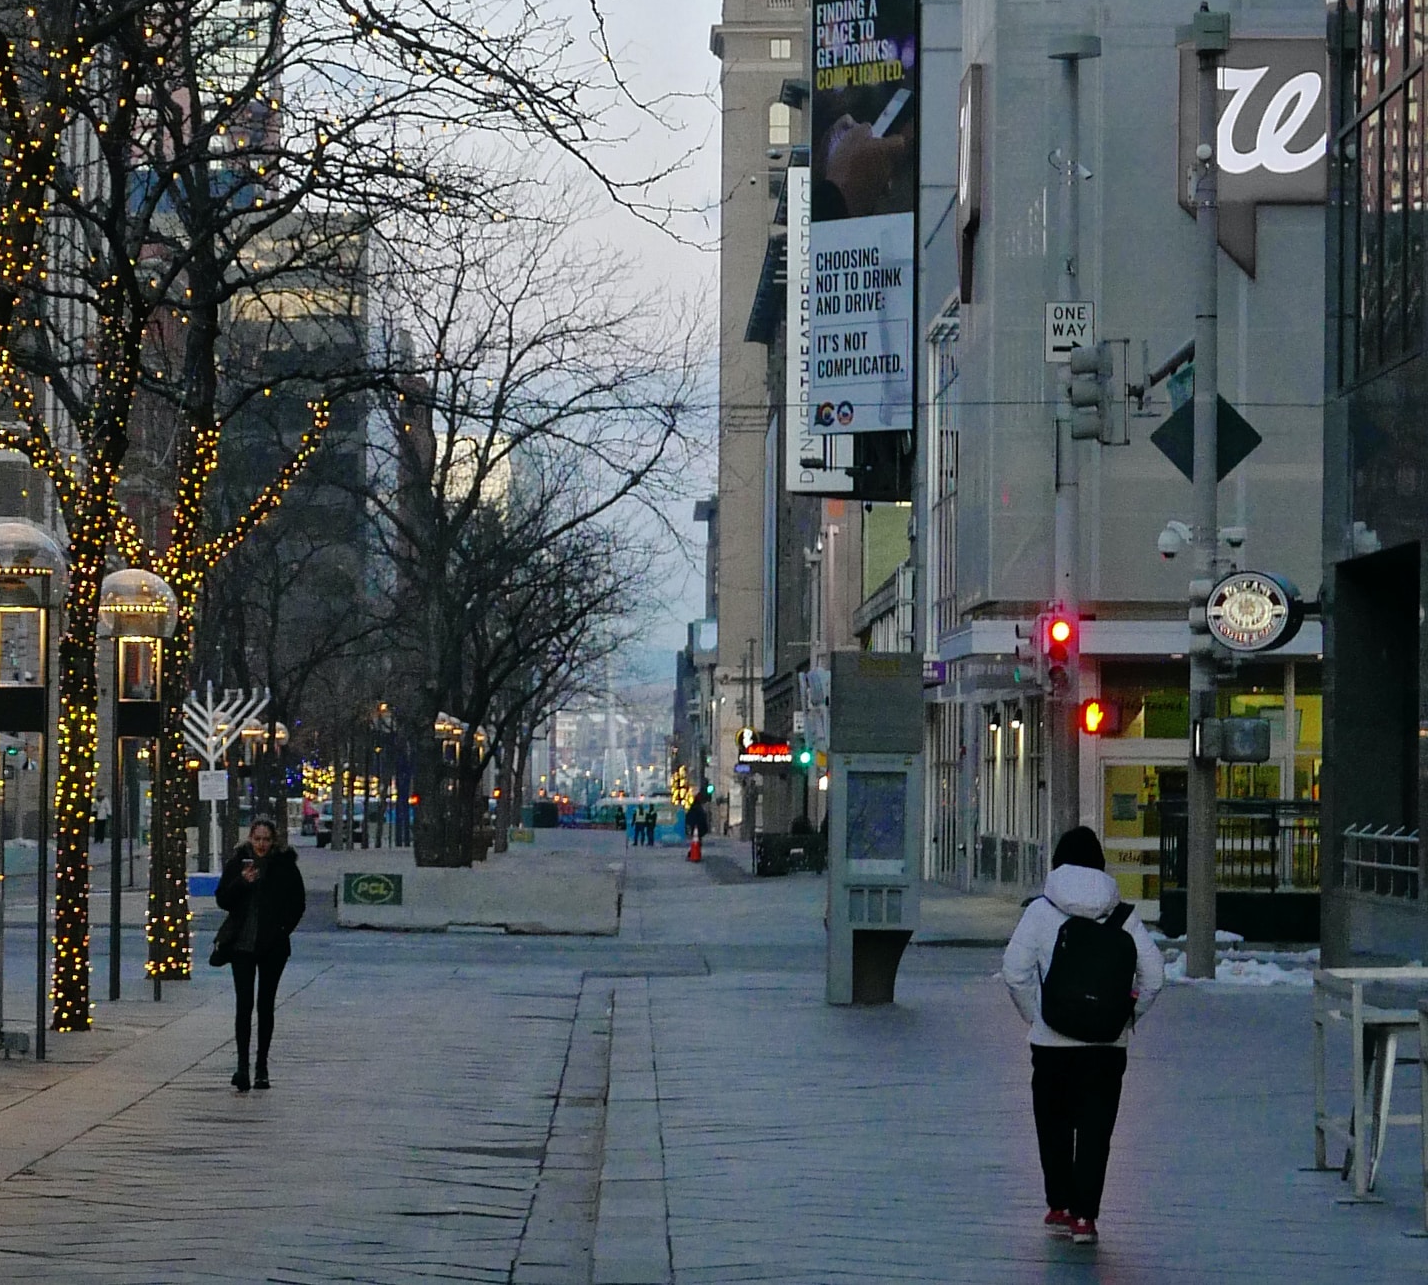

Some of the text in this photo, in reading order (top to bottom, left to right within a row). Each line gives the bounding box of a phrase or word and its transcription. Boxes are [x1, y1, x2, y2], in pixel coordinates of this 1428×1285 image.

[816, 0, 865, 25] FINDING
[816, 19, 875, 47] PLACE TO
[816, 46, 839, 69] GET
[816, 60, 905, 91] COMPLICATED.
[815, 248, 879, 272] CHOOSING
[815, 267, 902, 294] NOT TO DRINK
[815, 291, 886, 316] AND DRIVE:
[1053, 306, 1086, 320] ONE
[1053, 323, 1086, 336] WAY
[817, 331, 868, 354] IT'S NOT
[817, 354, 904, 379] COMPLICATED.
[357, 882, 389, 895] PCL
